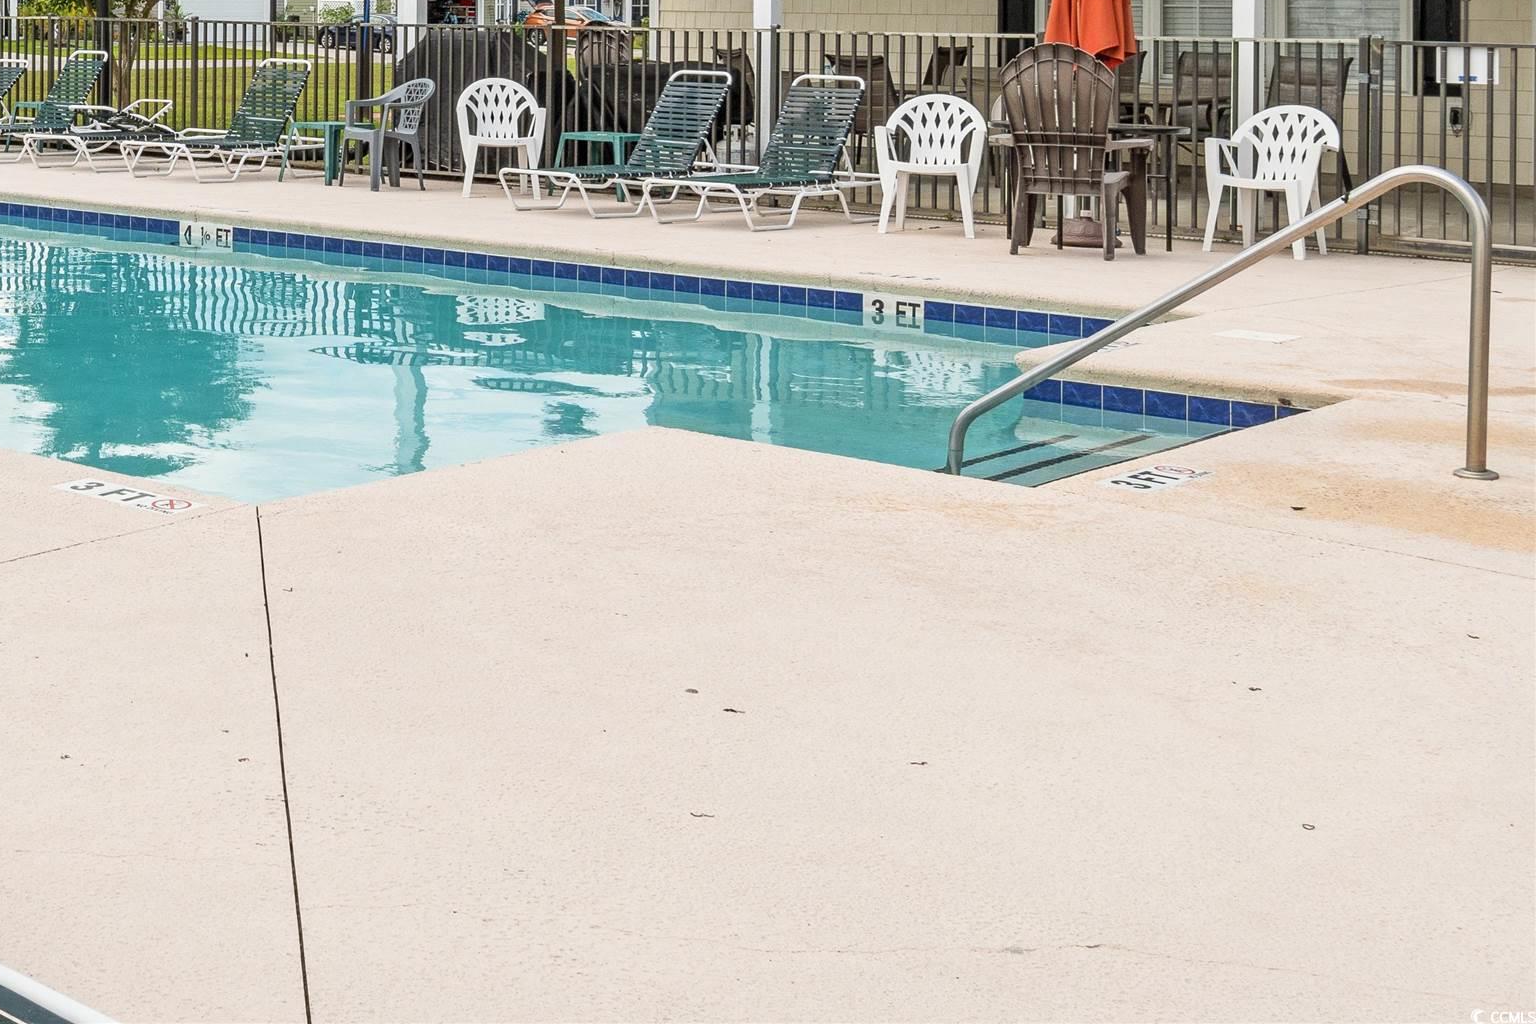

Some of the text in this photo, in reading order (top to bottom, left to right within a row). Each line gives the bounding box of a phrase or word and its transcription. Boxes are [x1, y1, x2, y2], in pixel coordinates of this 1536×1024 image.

[872, 299, 884, 324] 3
[1111, 480, 1152, 489] 3
[1128, 471, 1180, 484] FT
[70, 482, 156, 501] 3 FT
